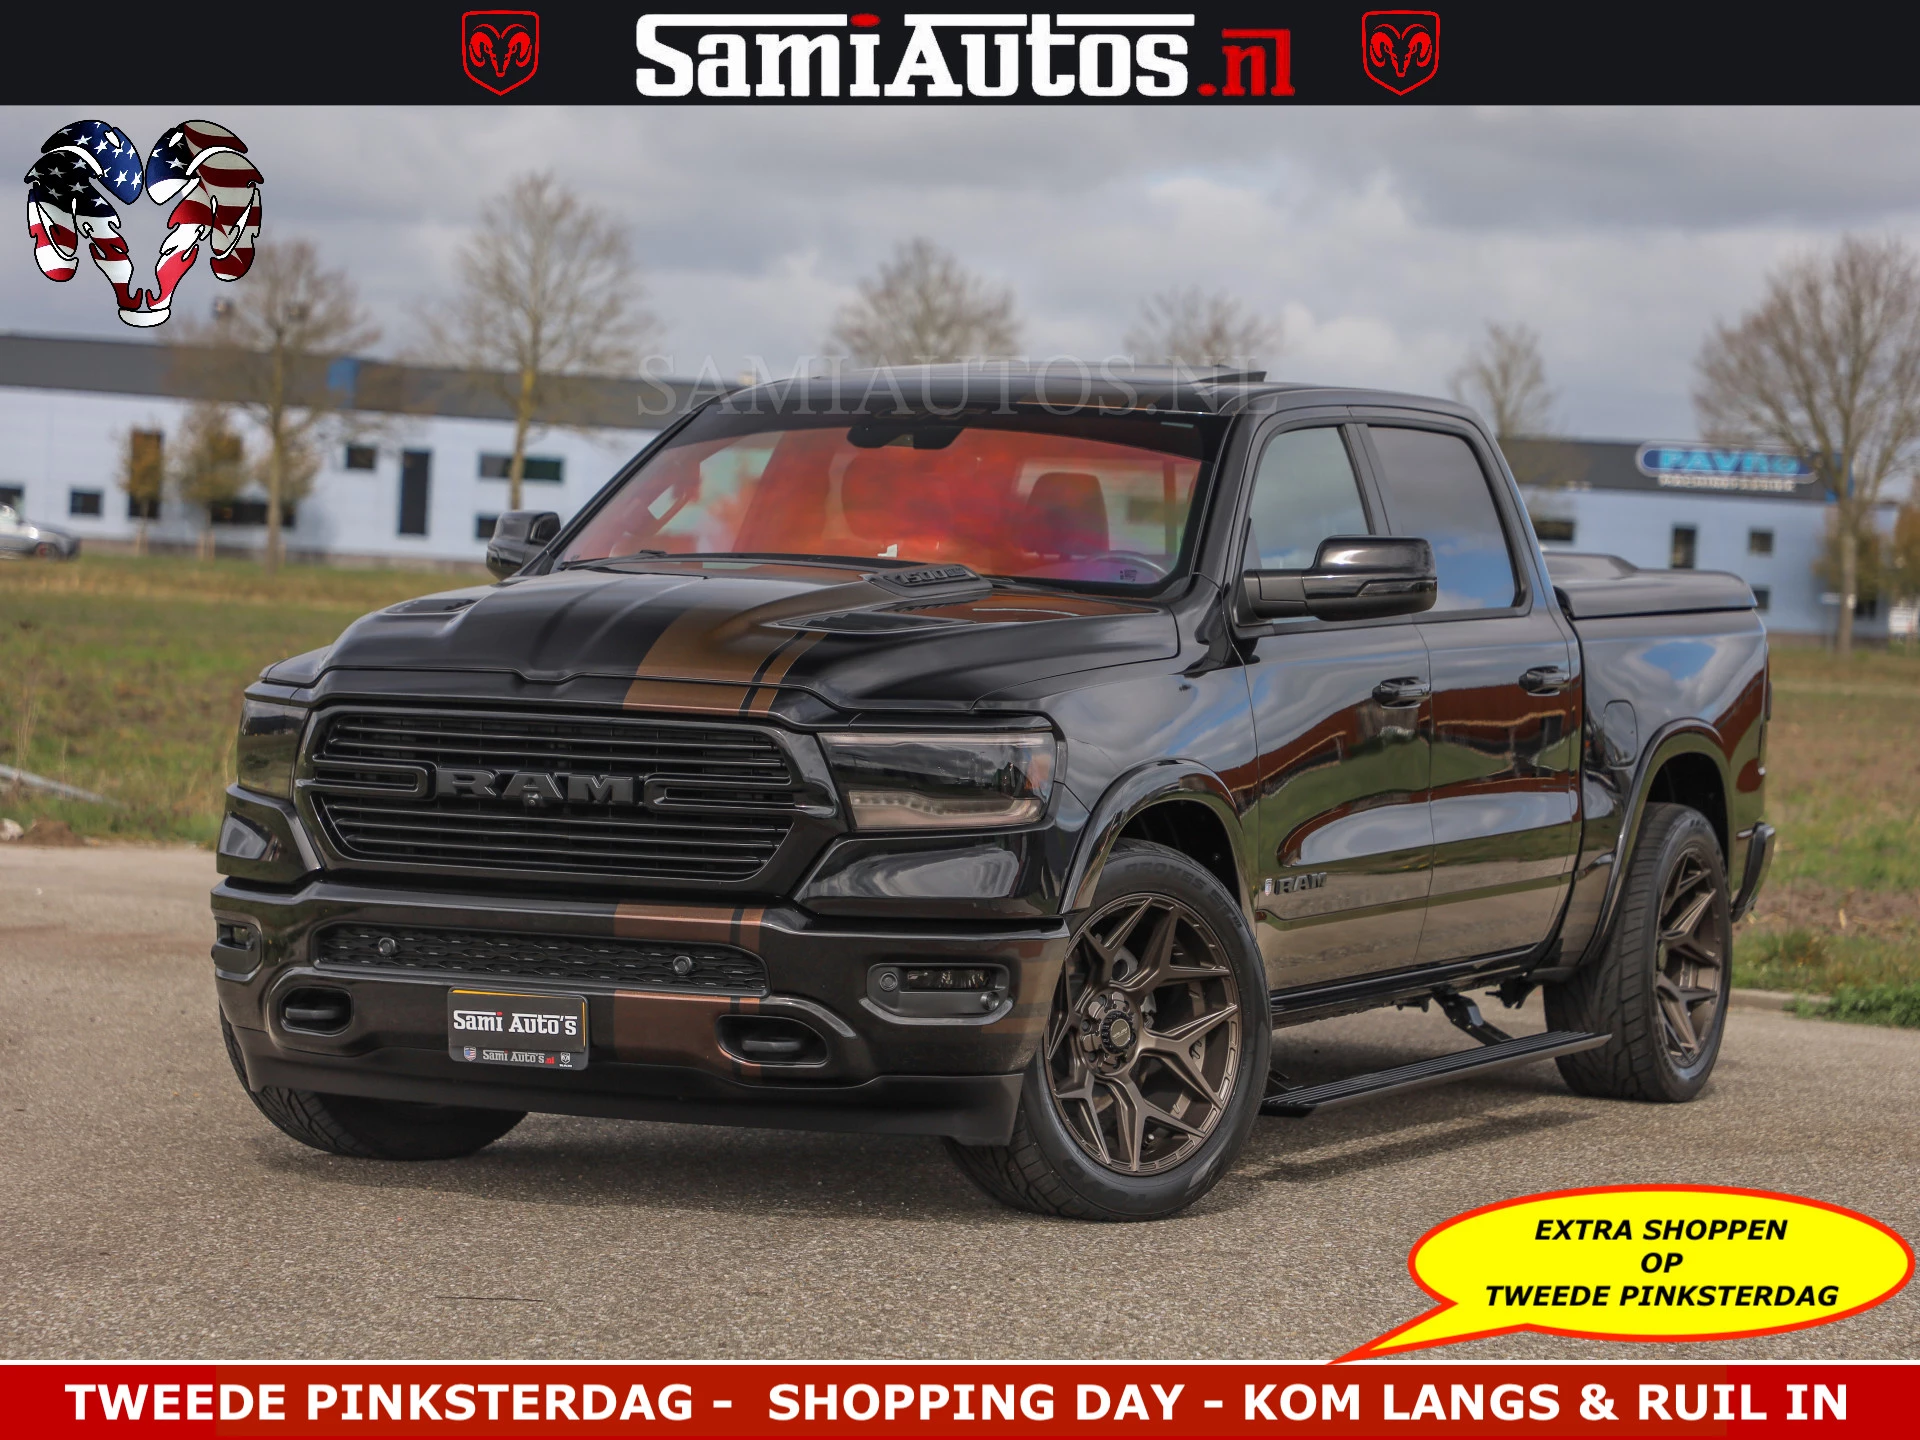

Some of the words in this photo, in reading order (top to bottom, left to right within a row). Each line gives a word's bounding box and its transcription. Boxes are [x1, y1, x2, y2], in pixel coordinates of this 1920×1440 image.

[437, 767, 633, 804] RAM
[1274, 872, 1327, 895] RAM
[453, 1010, 504, 1032] Sami
[508, 1013, 578, 1036] Auto's
[482, 1050, 508, 1062] Sami
